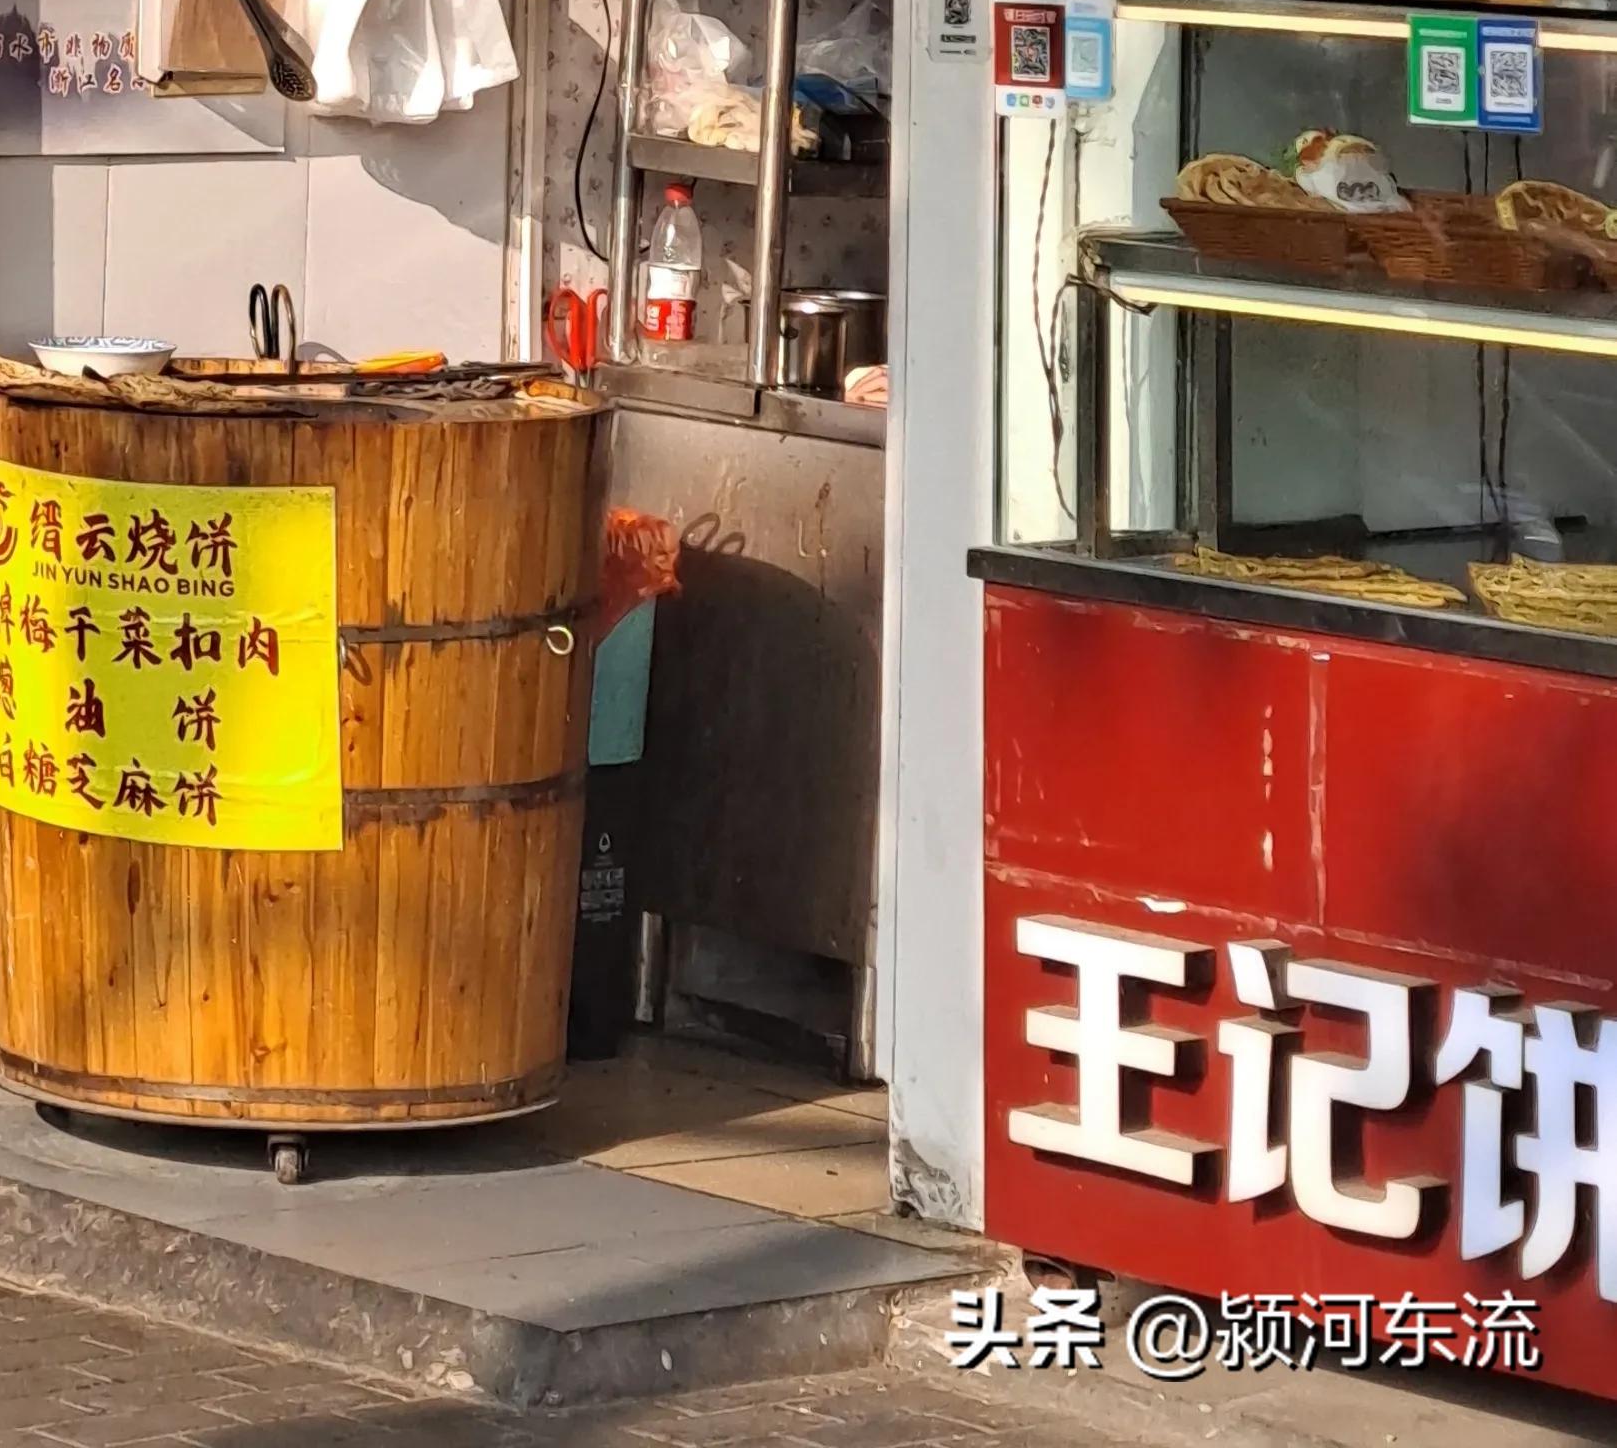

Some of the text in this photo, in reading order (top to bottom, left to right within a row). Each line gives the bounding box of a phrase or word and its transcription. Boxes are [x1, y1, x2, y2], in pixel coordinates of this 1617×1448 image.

[29, 500, 238, 577] 缙云烧饼
[32, 560, 235, 597] JIN YUN SHAO BING
[1009, 914, 1617, 1304] 王记饼
